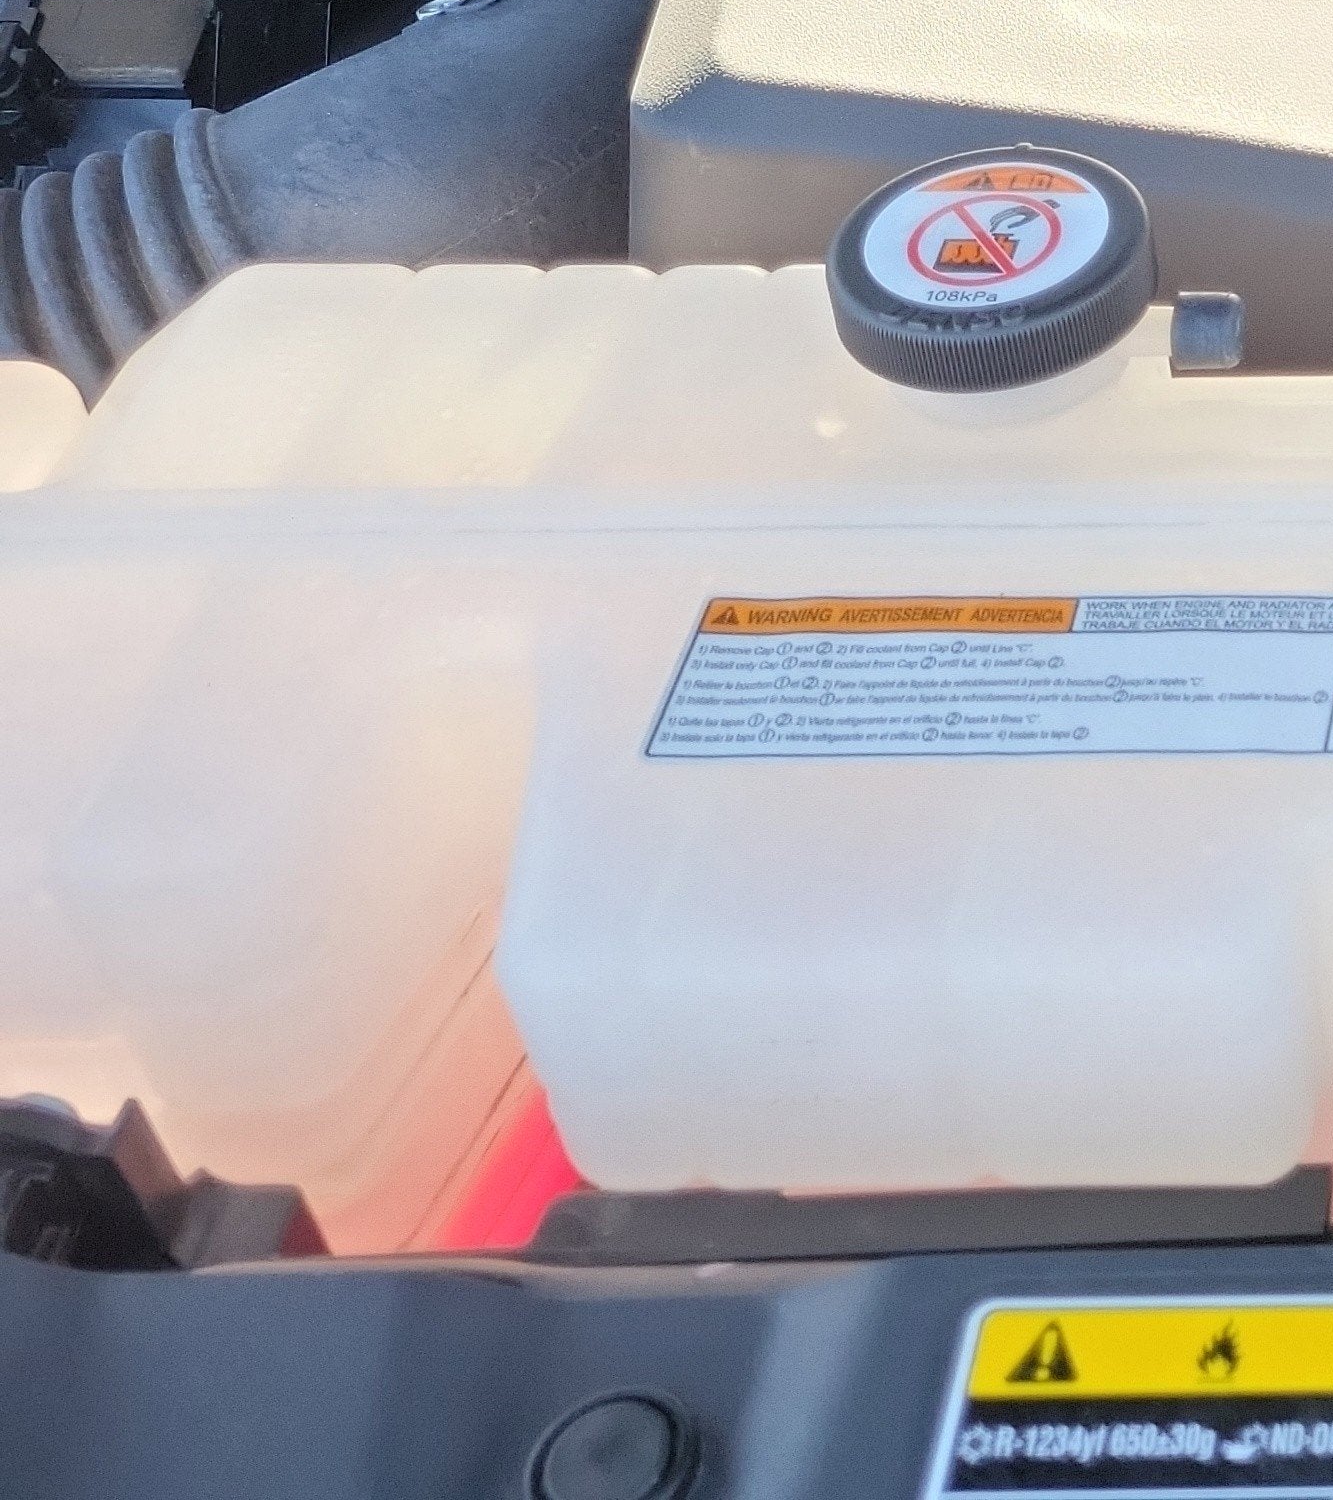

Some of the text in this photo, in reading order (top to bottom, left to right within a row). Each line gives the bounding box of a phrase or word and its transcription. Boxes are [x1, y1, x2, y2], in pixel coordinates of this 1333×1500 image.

[926, 290, 998, 302] 108kPa
[748, 608, 1064, 624] WARNING AVERTISSEMENT ADVERTENCIA
